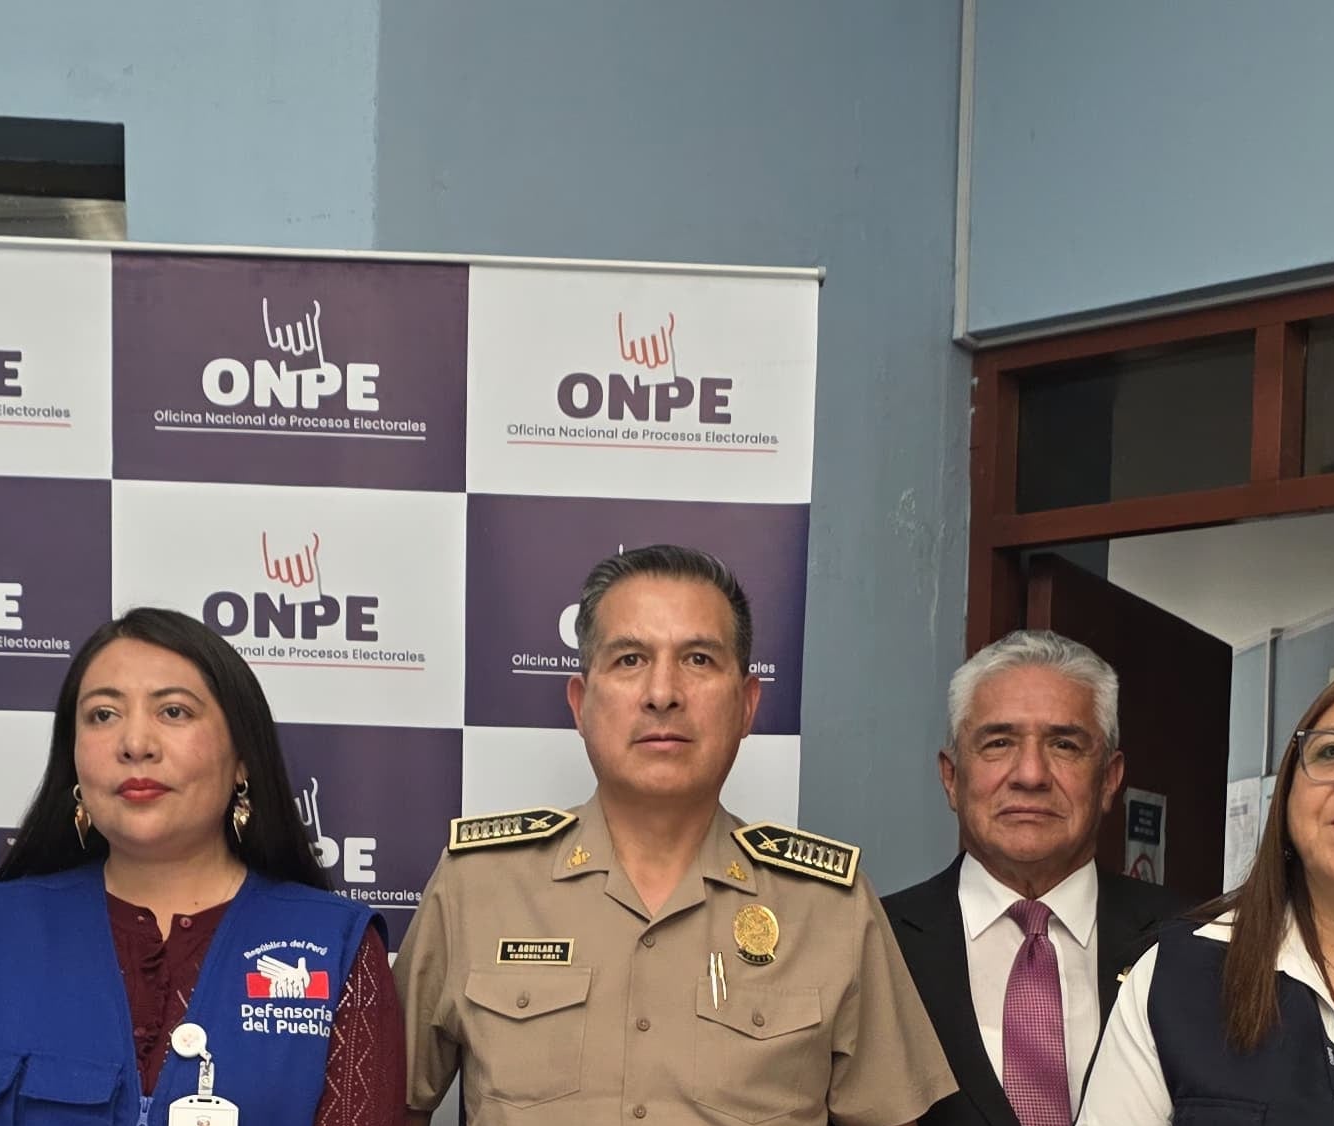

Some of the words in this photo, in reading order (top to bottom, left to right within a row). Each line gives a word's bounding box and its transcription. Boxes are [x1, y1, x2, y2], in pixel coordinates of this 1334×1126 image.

[202, 357, 380, 412] ONPE
[557, 373, 733, 425] ONPE
[154, 410, 202, 424] Oficina
[205, 412, 266, 426] Nacional
[269, 413, 286, 427] de
[289, 415, 351, 429] Procesos
[353, 417, 427, 432] Electorales
[507, 424, 556, 437] Oficina
[559, 426, 618, 439] Nacional
[622, 427, 639, 440] de
[642, 429, 702, 442] Procesos
[706, 431, 779, 445] Electorales
[202, 591, 379, 642] ONPE
[268, 645, 285, 657] de
[289, 646, 349, 660] Procesos
[352, 648, 426, 663] Electorales
[512, 654, 558, 667] Oficina
[351, 889, 422, 901] Electorales
[289, 939, 305, 948] del
[241, 1003, 333, 1022] Defensoría
[243, 1017, 270, 1034] del
[276, 1019, 331, 1038] Pueblo
